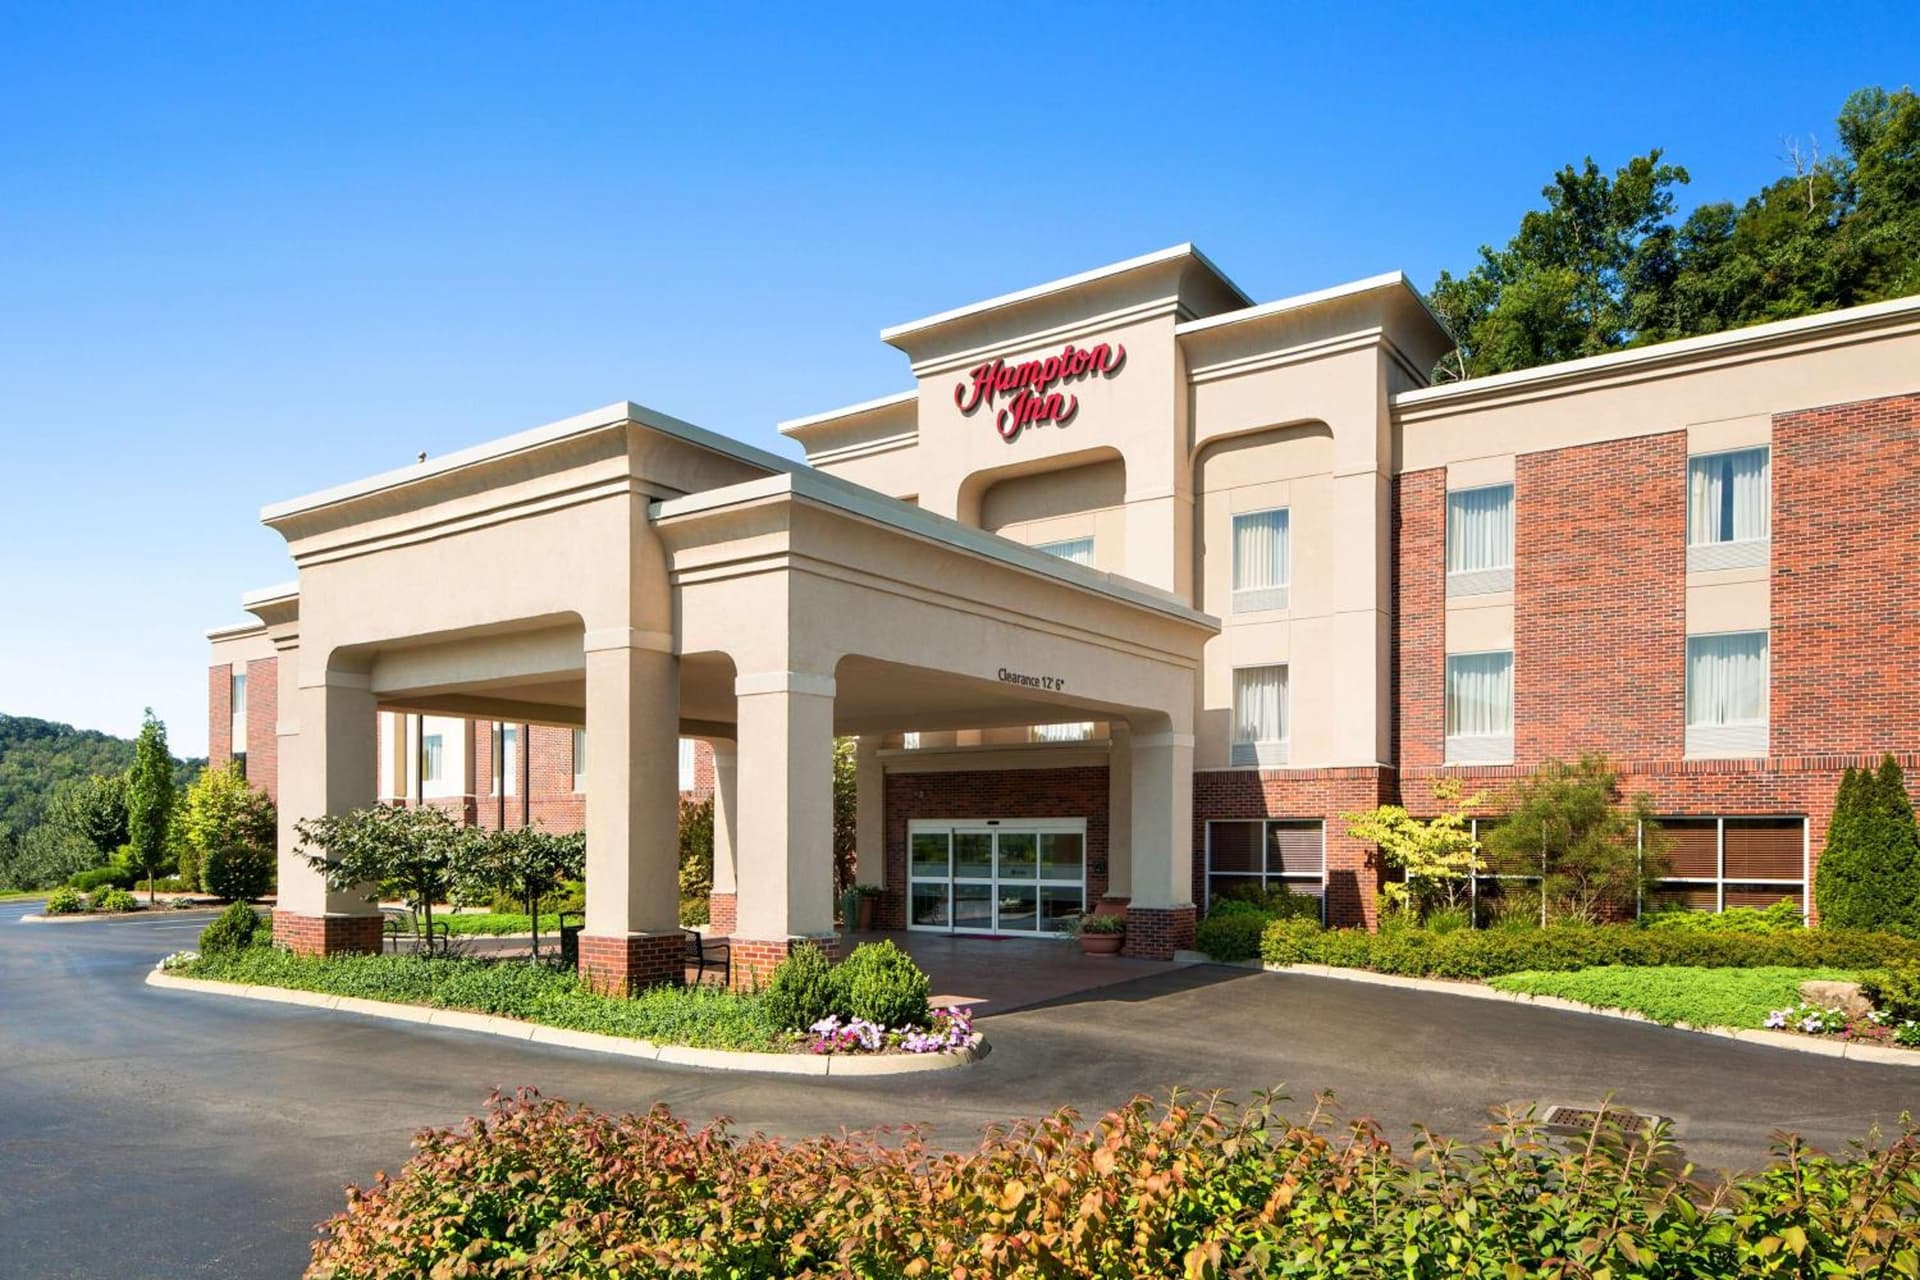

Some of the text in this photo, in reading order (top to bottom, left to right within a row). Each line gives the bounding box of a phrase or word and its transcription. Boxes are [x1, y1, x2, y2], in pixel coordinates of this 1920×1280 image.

[955, 343, 1126, 415] Hampton
[997, 389, 1078, 441] Inn
[998, 668, 1040, 687] Clearance
